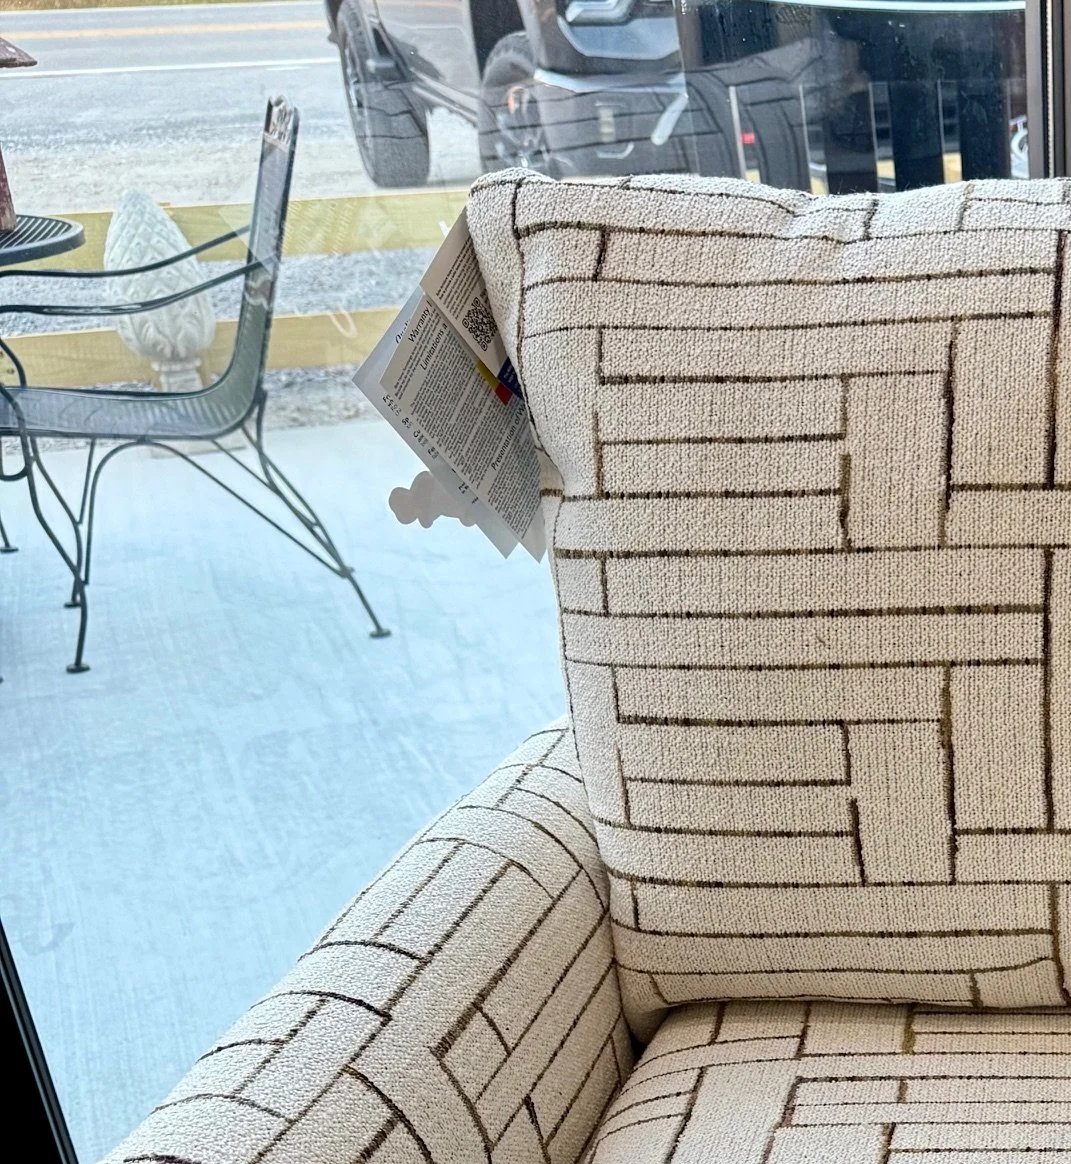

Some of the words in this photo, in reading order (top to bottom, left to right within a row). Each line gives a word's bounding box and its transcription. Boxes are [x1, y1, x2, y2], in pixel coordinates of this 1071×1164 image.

[408, 307, 431, 343] Warranty
[420, 328, 445, 371] Limitations
[491, 425, 517, 471] Presentation
